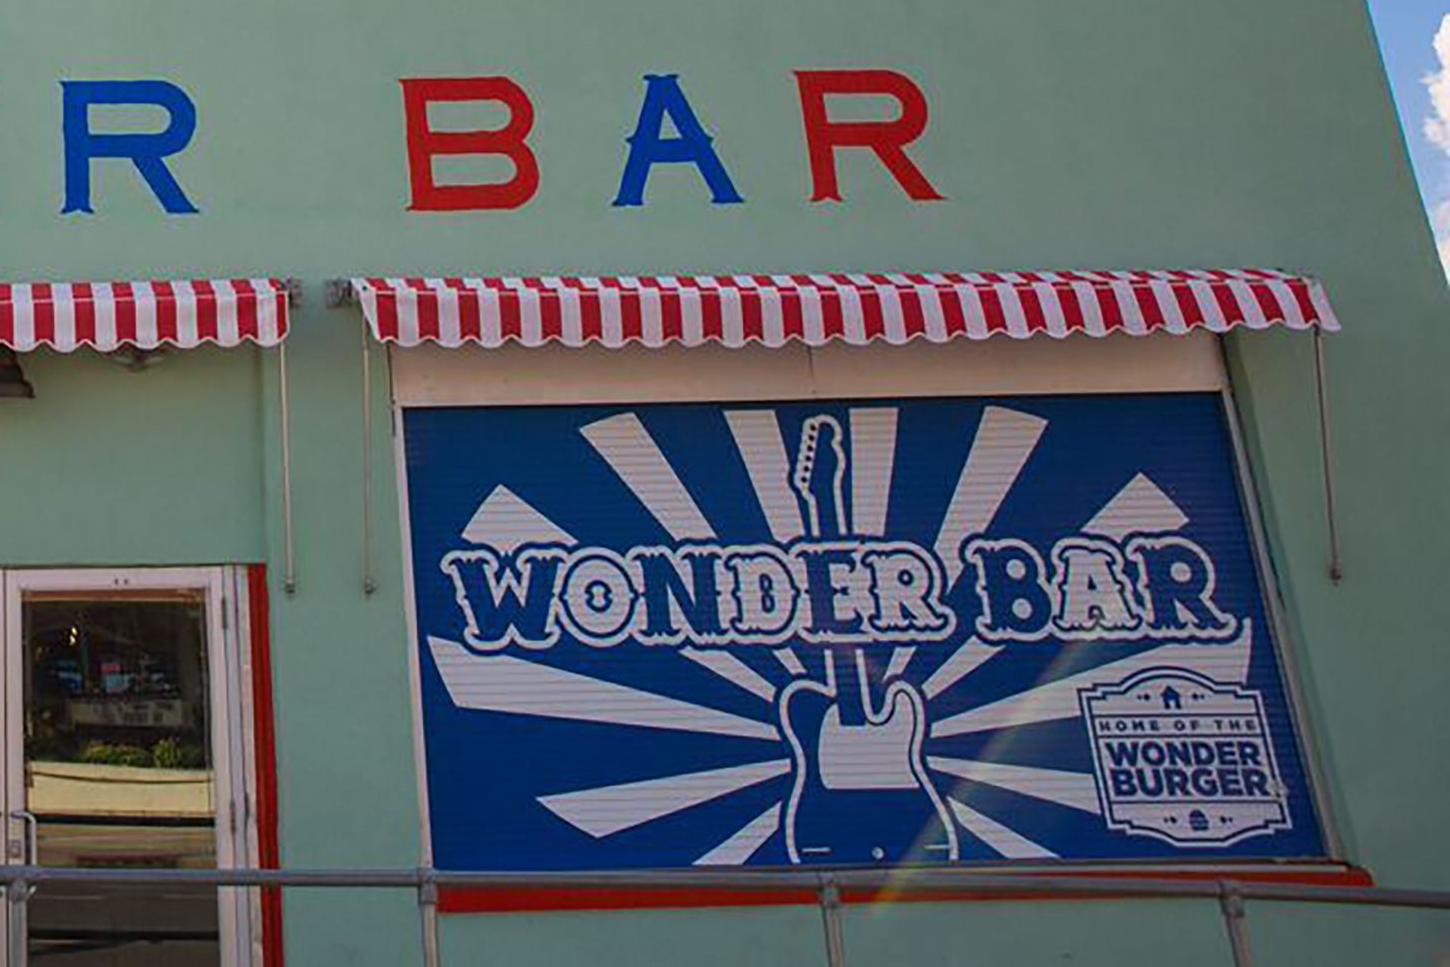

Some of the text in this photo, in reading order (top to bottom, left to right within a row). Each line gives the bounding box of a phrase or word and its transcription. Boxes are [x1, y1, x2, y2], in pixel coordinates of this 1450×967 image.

[399, 70, 946, 211] BAR
[443, 537, 1236, 649] WONDER BAR
[1099, 719, 1258, 732] HOME OF THE
[1105, 740, 1261, 766] WONDER
[1110, 768, 1271, 797] BURGER
